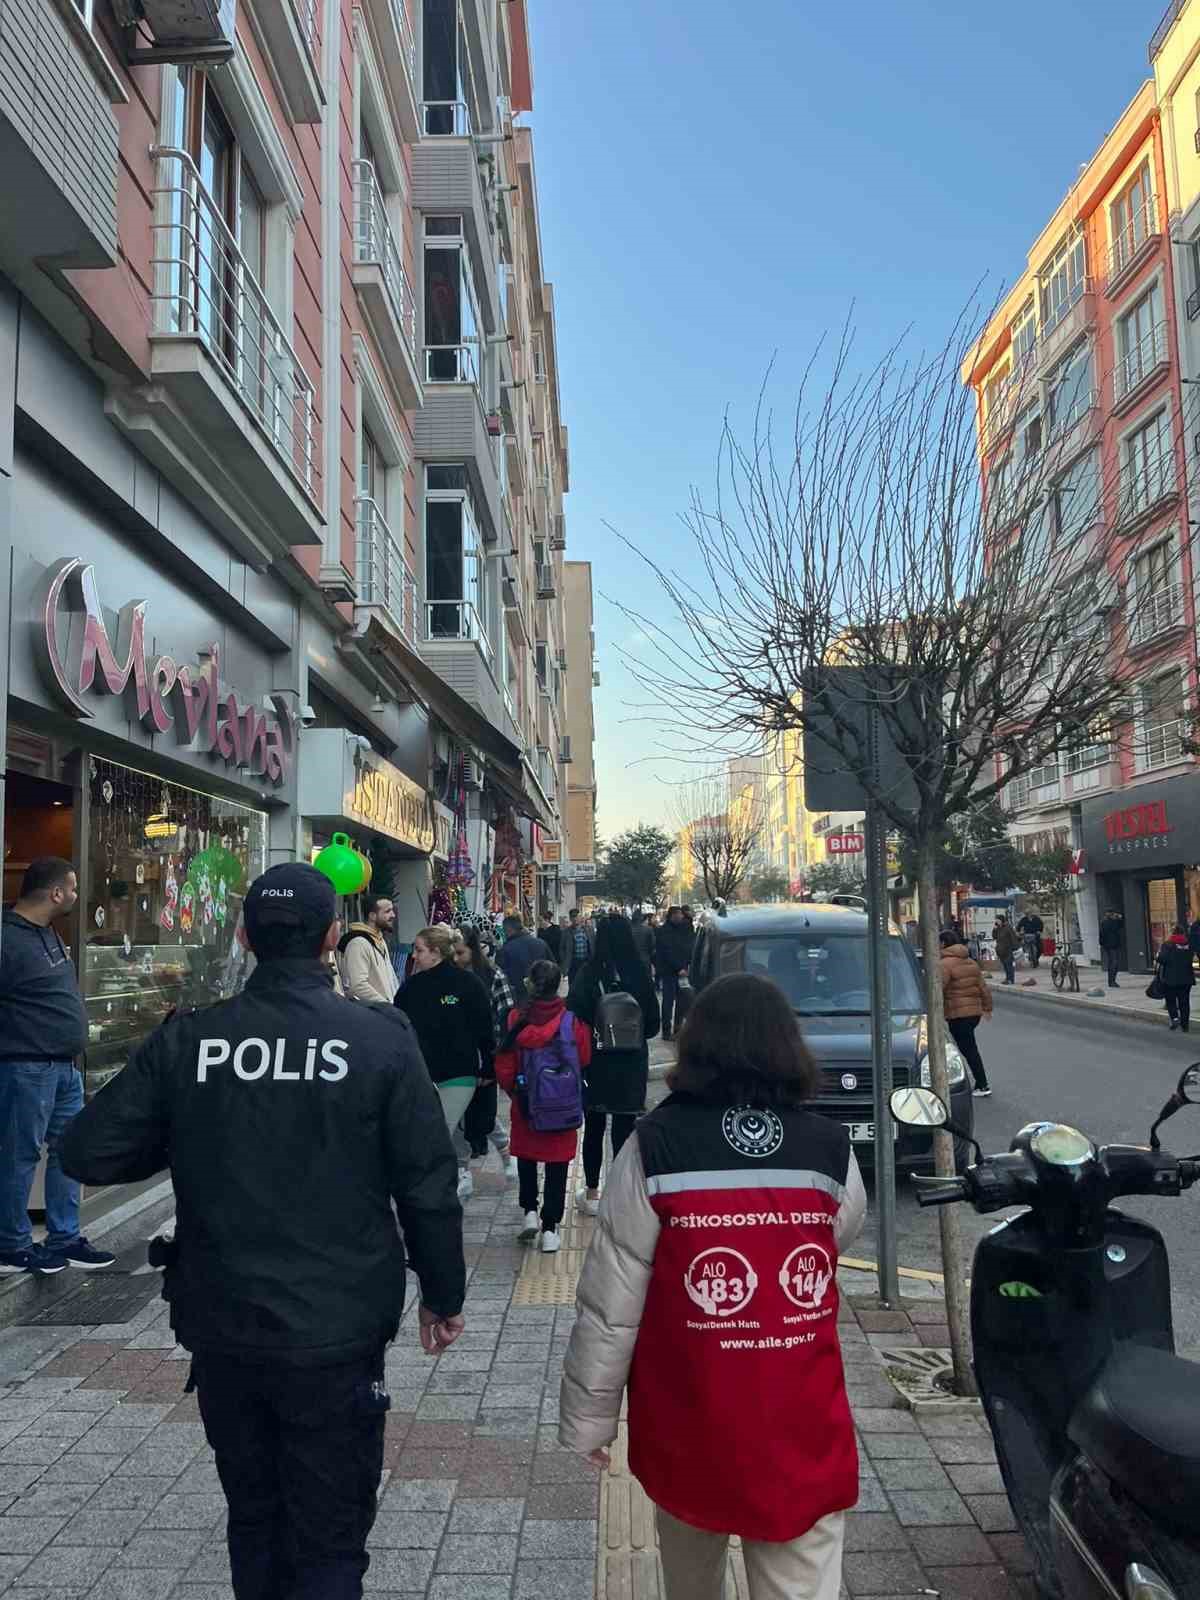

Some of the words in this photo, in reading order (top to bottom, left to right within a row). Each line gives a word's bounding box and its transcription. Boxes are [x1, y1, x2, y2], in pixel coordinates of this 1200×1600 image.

[80, 562, 288, 787] Mevlana
[702, 1261, 726, 1278] ALO
[797, 1255, 816, 1272] ALO
[696, 1277, 744, 1302] 183
[720, 1332, 816, 1350] www.aile.gov.tr
